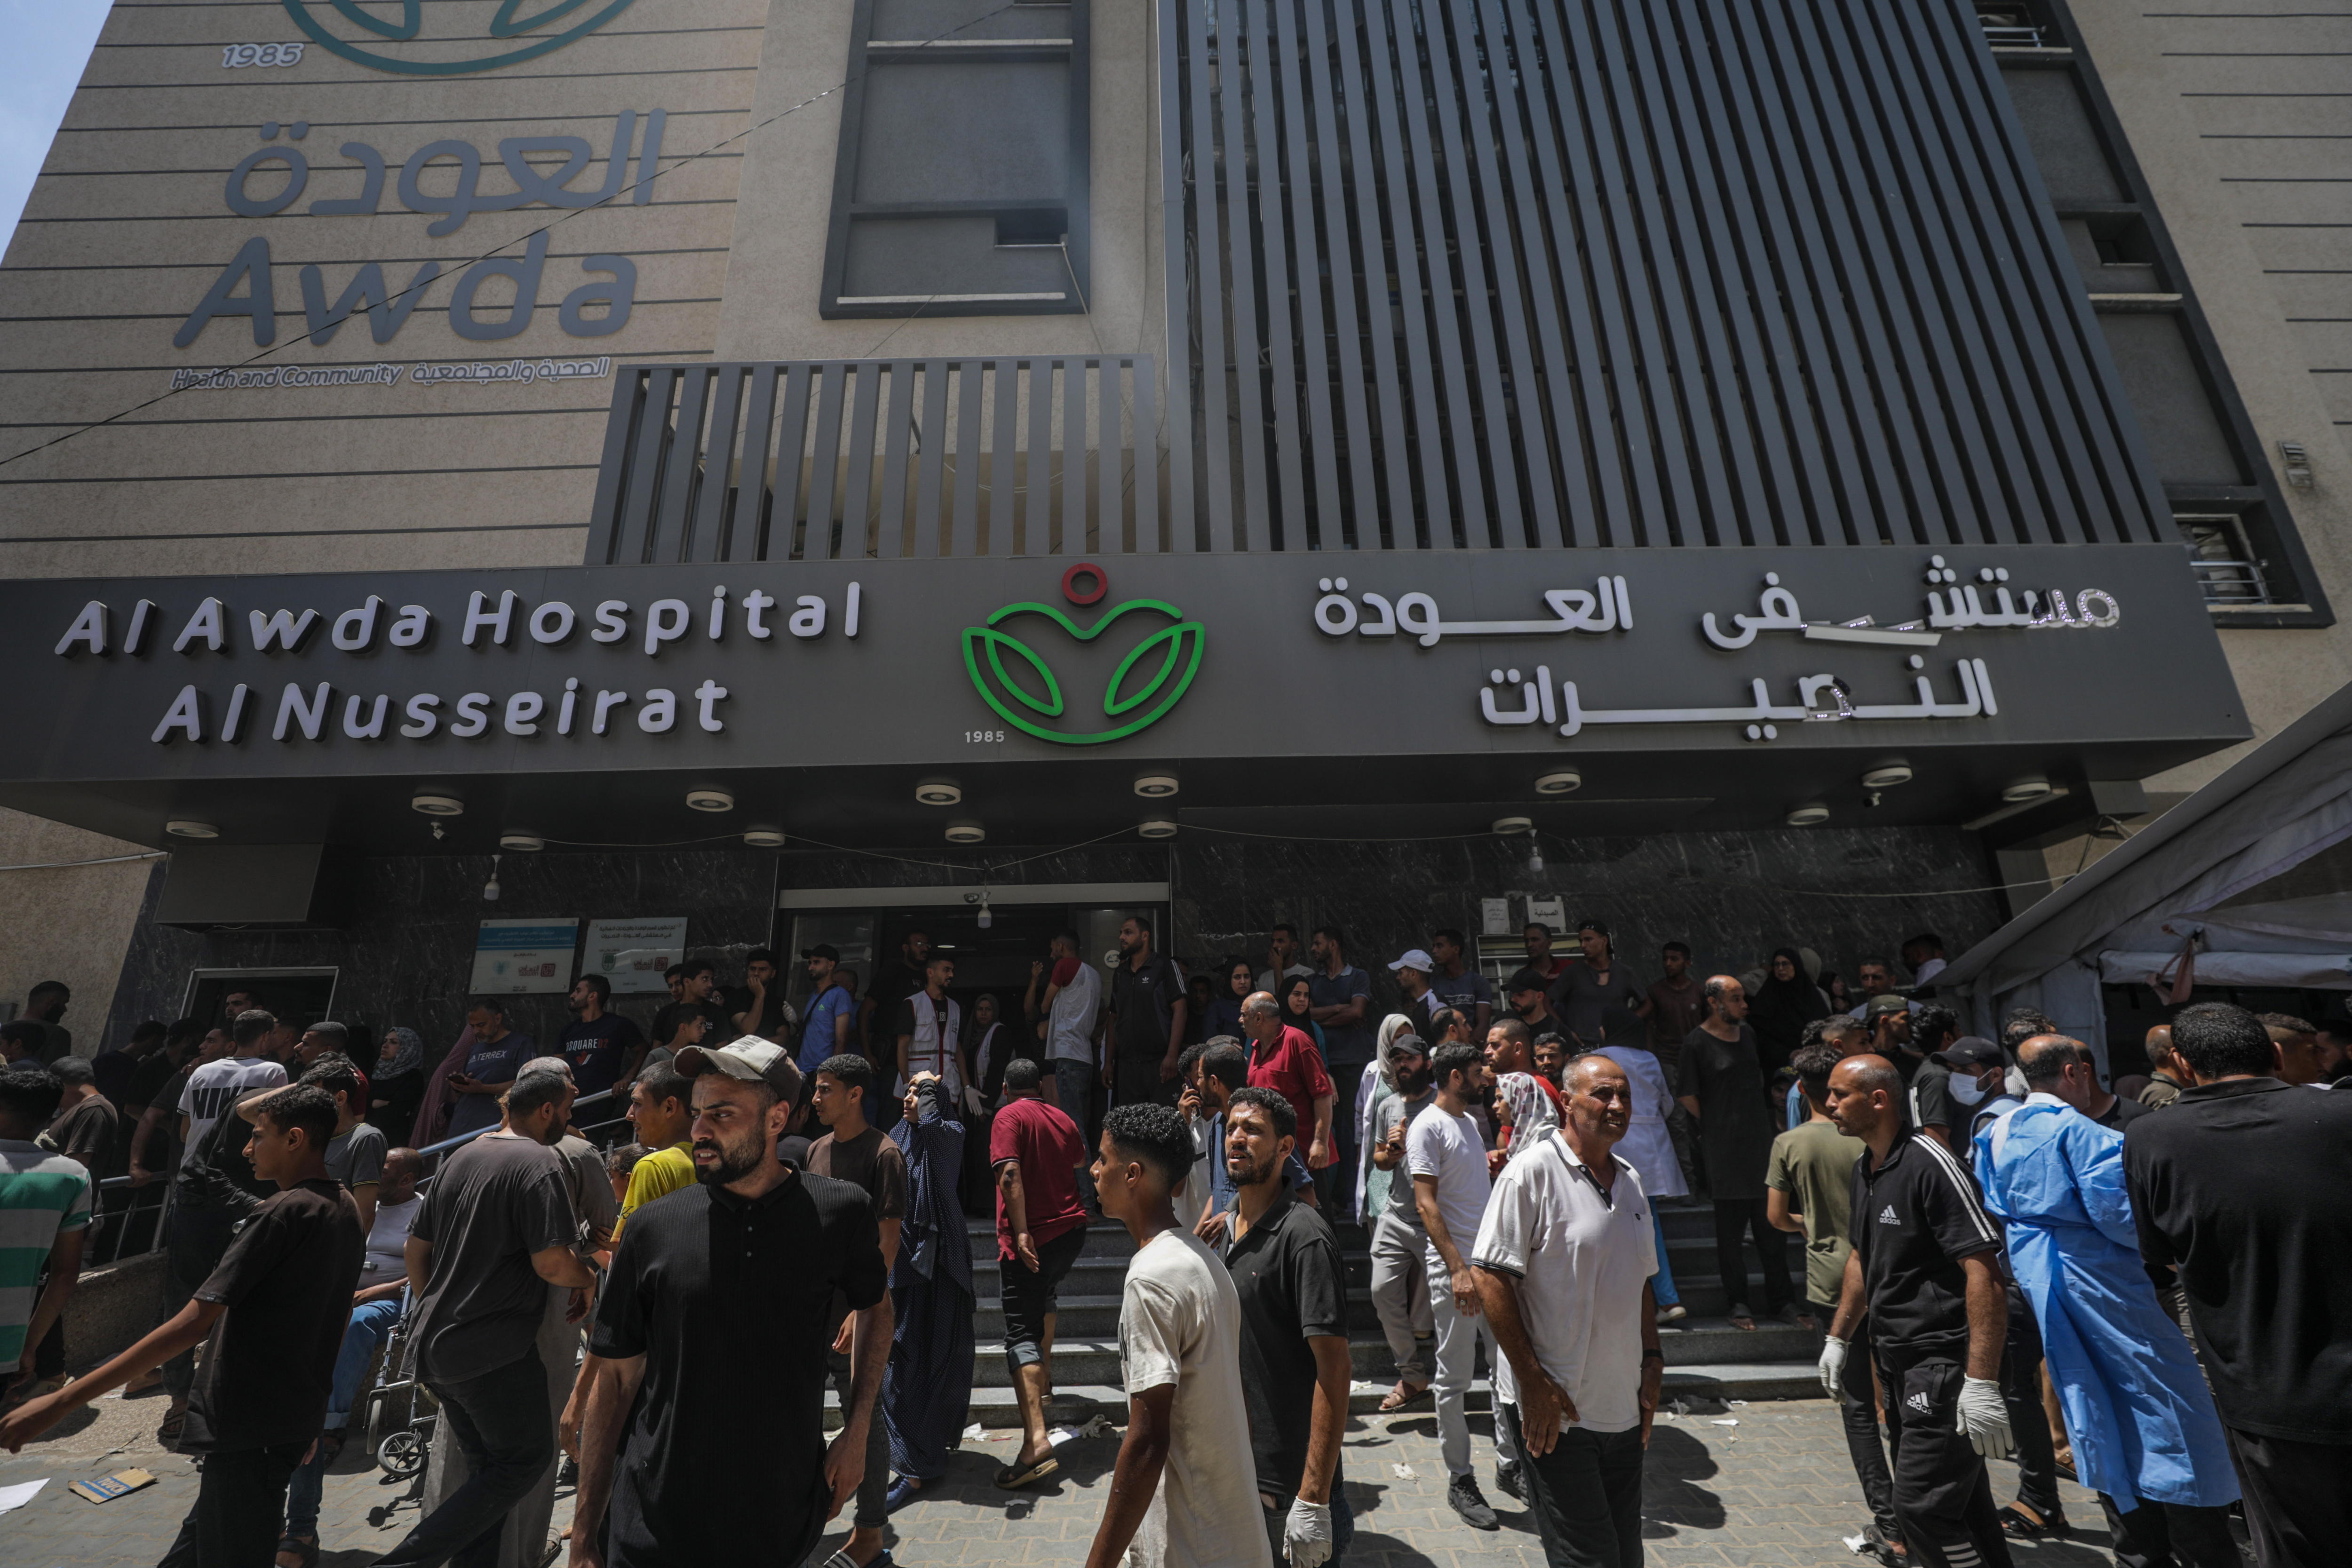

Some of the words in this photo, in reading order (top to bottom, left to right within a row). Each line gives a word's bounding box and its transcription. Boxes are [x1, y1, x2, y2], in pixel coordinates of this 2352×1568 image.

[222, 43, 303, 67] 1985
[225, 109, 667, 237] العودة
[173, 229, 637, 348] Awda
[171, 369, 236, 389] Health
[238, 367, 280, 387] and
[281, 365, 403, 385] Community
[412, 361, 535, 385] والمجتمعية
[539, 358, 609, 381] الصحية
[1315, 575, 1633, 647] العودة
[1702, 555, 2121, 649] مستشفى
[55, 599, 157, 656] Al
[173, 595, 431, 653] Awda
[462, 581, 861, 655] Hospital
[151, 684, 247, 743] Al
[273, 677, 728, 740] Nusseirat
[1481, 659, 1997, 740] النصيرات
[965, 731, 1005, 743] 1985
[1534, 908, 1559, 918] الصيدلية
[477, 1050, 508, 1061] TERREX
[192, 1086, 260, 1119] NIK
[1879, 1217, 1901, 1226] adidas
[1907, 1399, 1933, 1415] adidas
